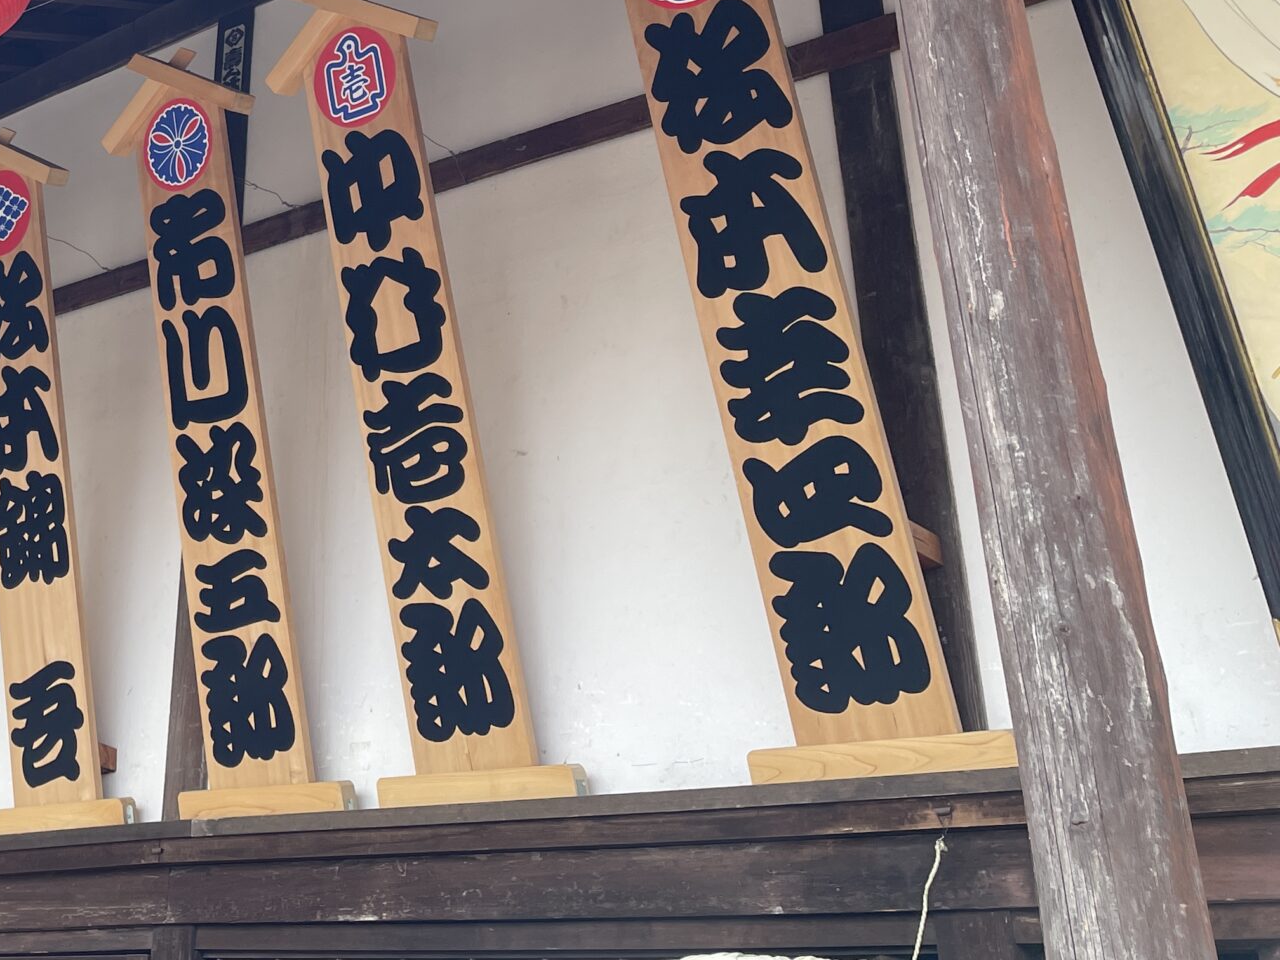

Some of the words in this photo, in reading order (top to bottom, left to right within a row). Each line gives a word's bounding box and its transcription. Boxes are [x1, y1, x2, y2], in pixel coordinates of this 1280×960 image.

[149, 188, 297, 768] 市川染五郎
